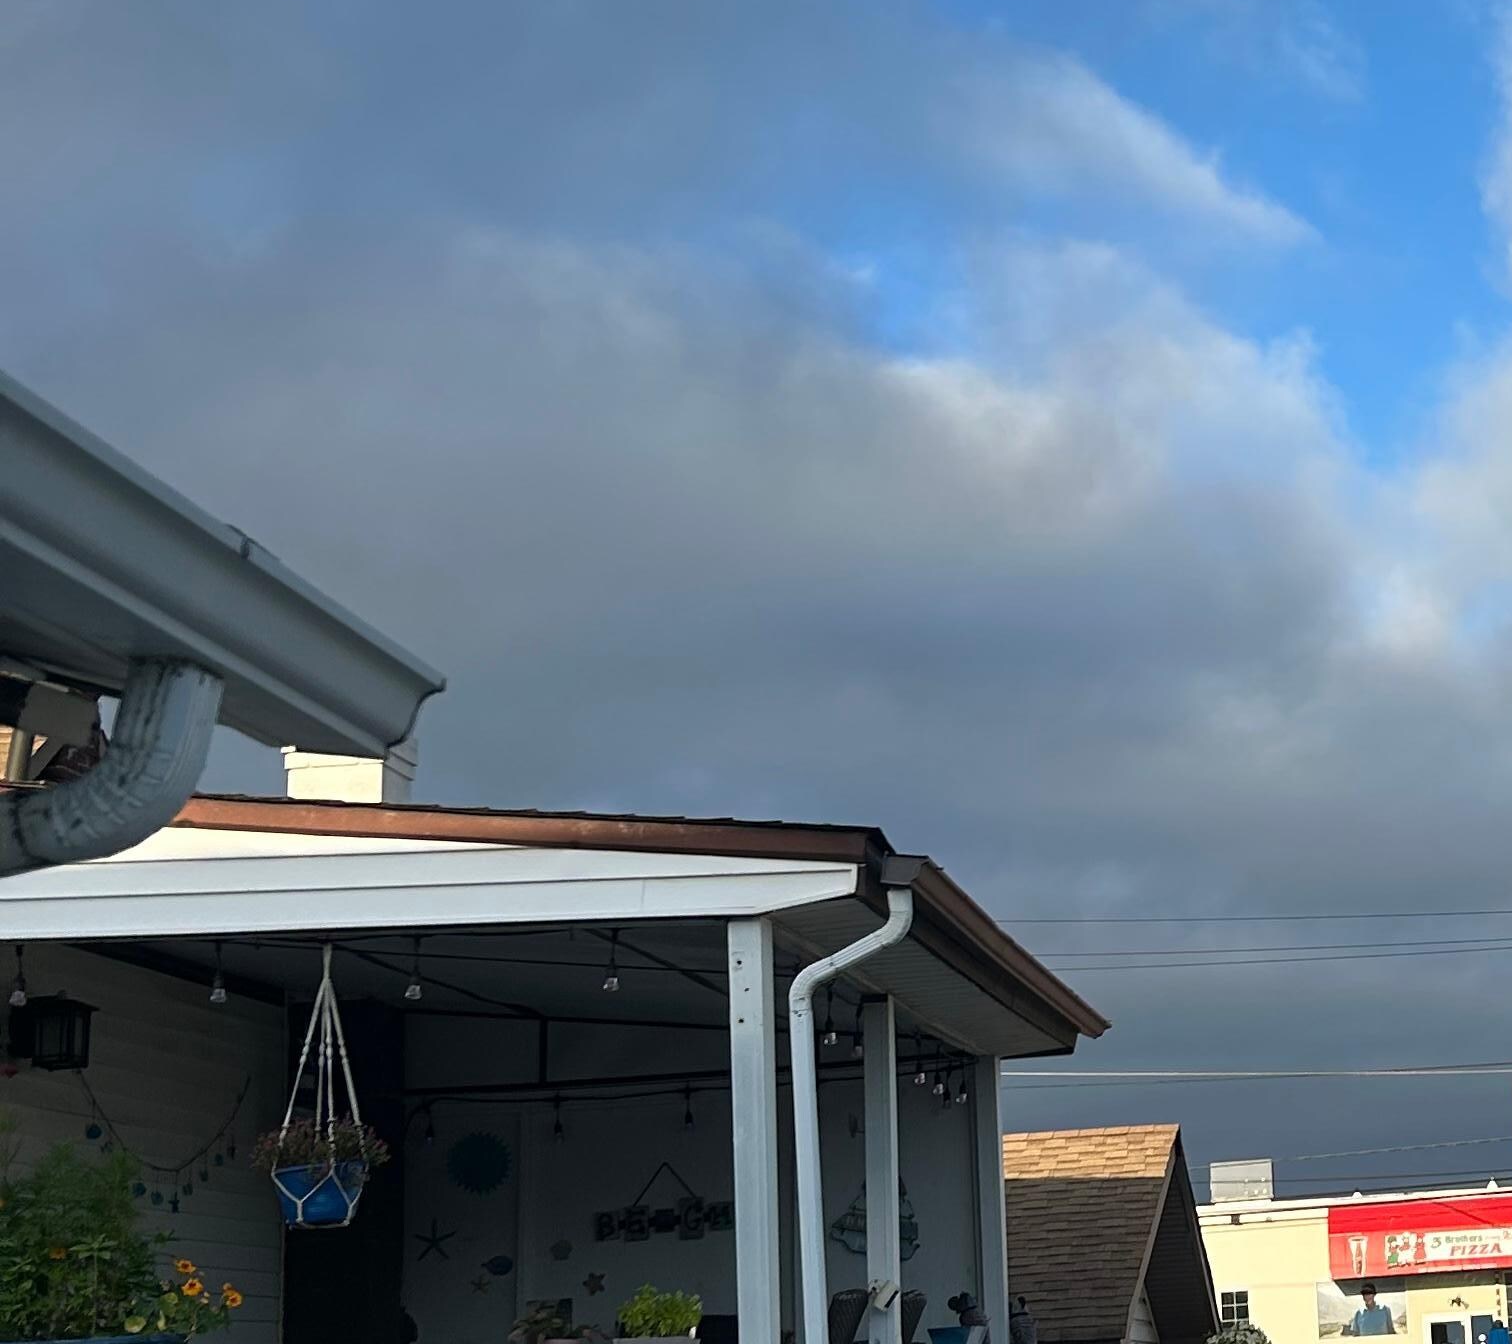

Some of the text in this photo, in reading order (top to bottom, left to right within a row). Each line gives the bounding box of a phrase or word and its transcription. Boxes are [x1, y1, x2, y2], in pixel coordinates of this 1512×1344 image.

[1430, 1236, 1442, 1249] 3
[1445, 1234, 1483, 1244] Brothers
[1449, 1243, 1502, 1257] PIZZA
